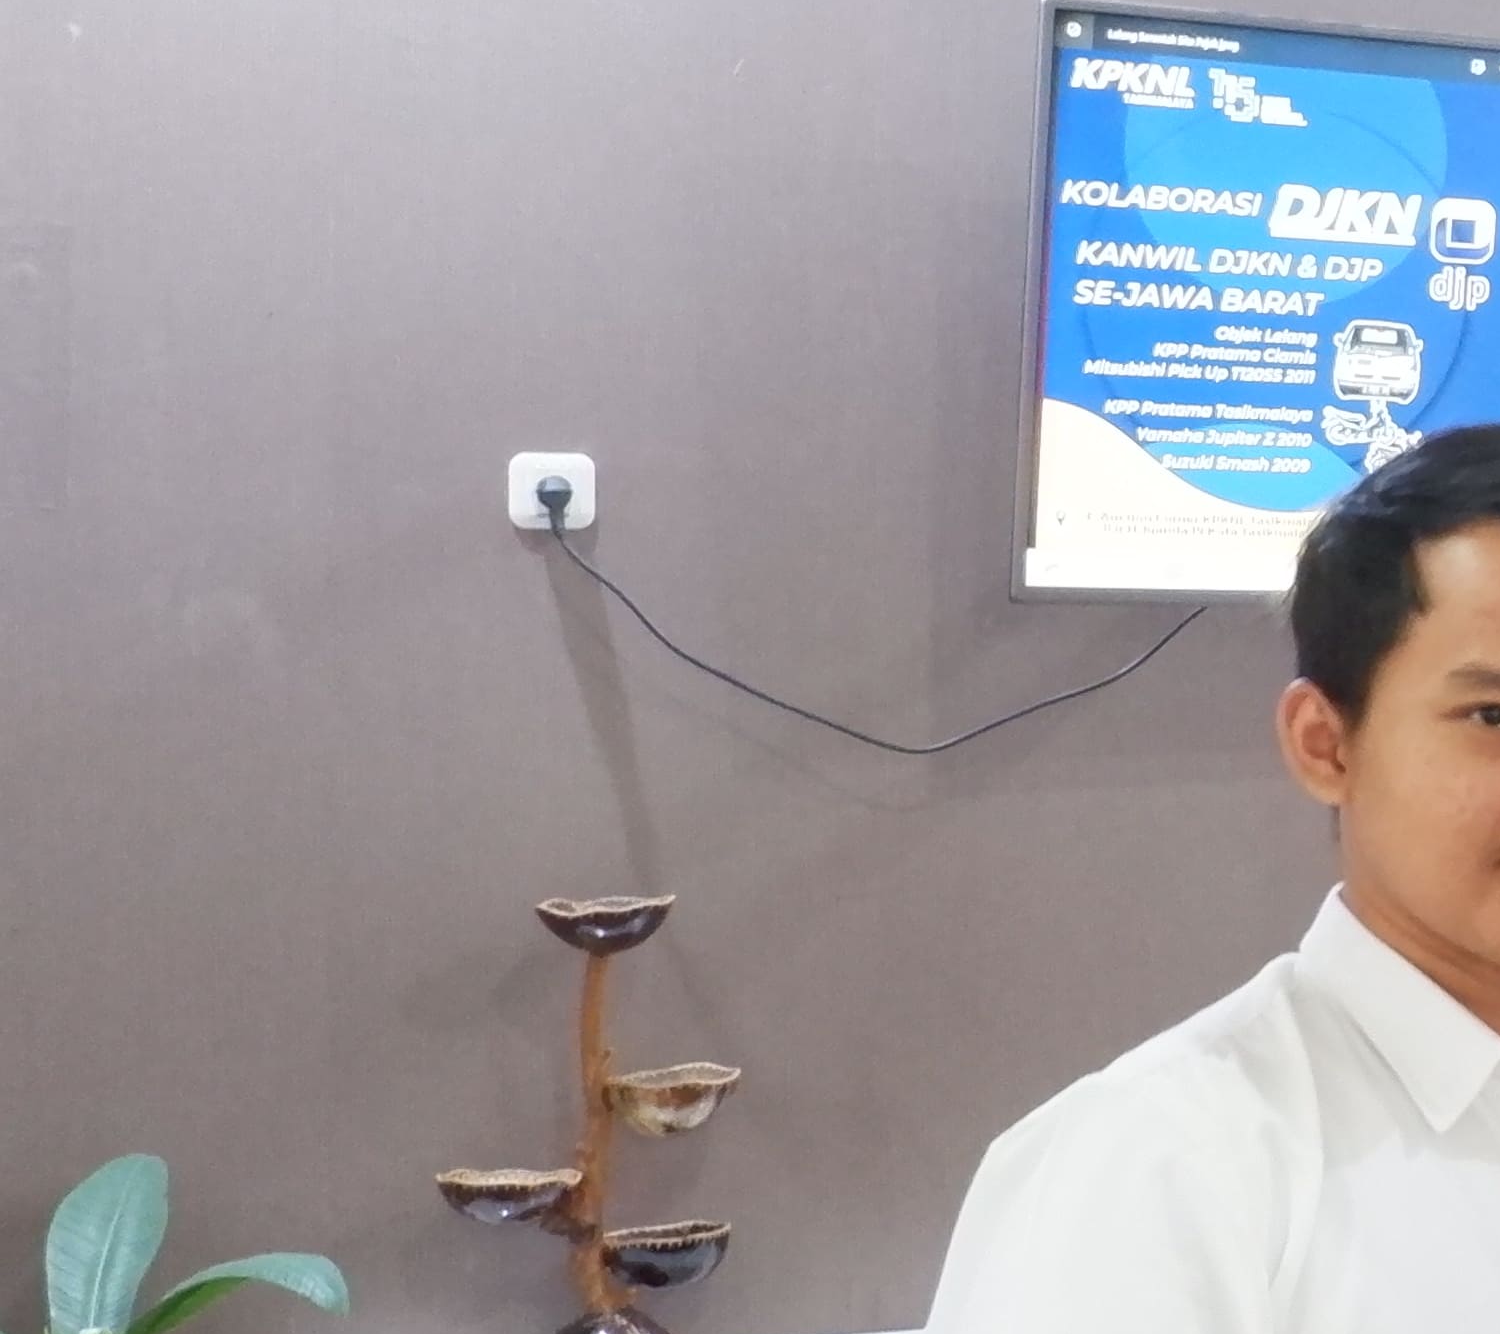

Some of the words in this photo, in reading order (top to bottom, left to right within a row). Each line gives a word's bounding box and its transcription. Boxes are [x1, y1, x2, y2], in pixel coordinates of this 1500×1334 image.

[1070, 57, 1196, 98] KPKNL
[1060, 179, 1264, 218] KOLABORASI
[1267, 183, 1423, 246] DJKN
[1075, 240, 1202, 273] KANWIL
[1208, 248, 1293, 278] DJKN
[1296, 255, 1318, 278] &
[1323, 256, 1384, 283] DJP
[1073, 279, 1214, 312] SE-JAWA
[1220, 288, 1326, 318] BARAT
[1427, 265, 1490, 312] djp
[1153, 342, 1189, 358] KPP
[1204, 365, 1229, 382] Up
[1104, 399, 1140, 415] KPP
[1136, 427, 1205, 443] Yamaha
[1262, 432, 1276, 446] Z
[1277, 432, 1314, 448] 2010
